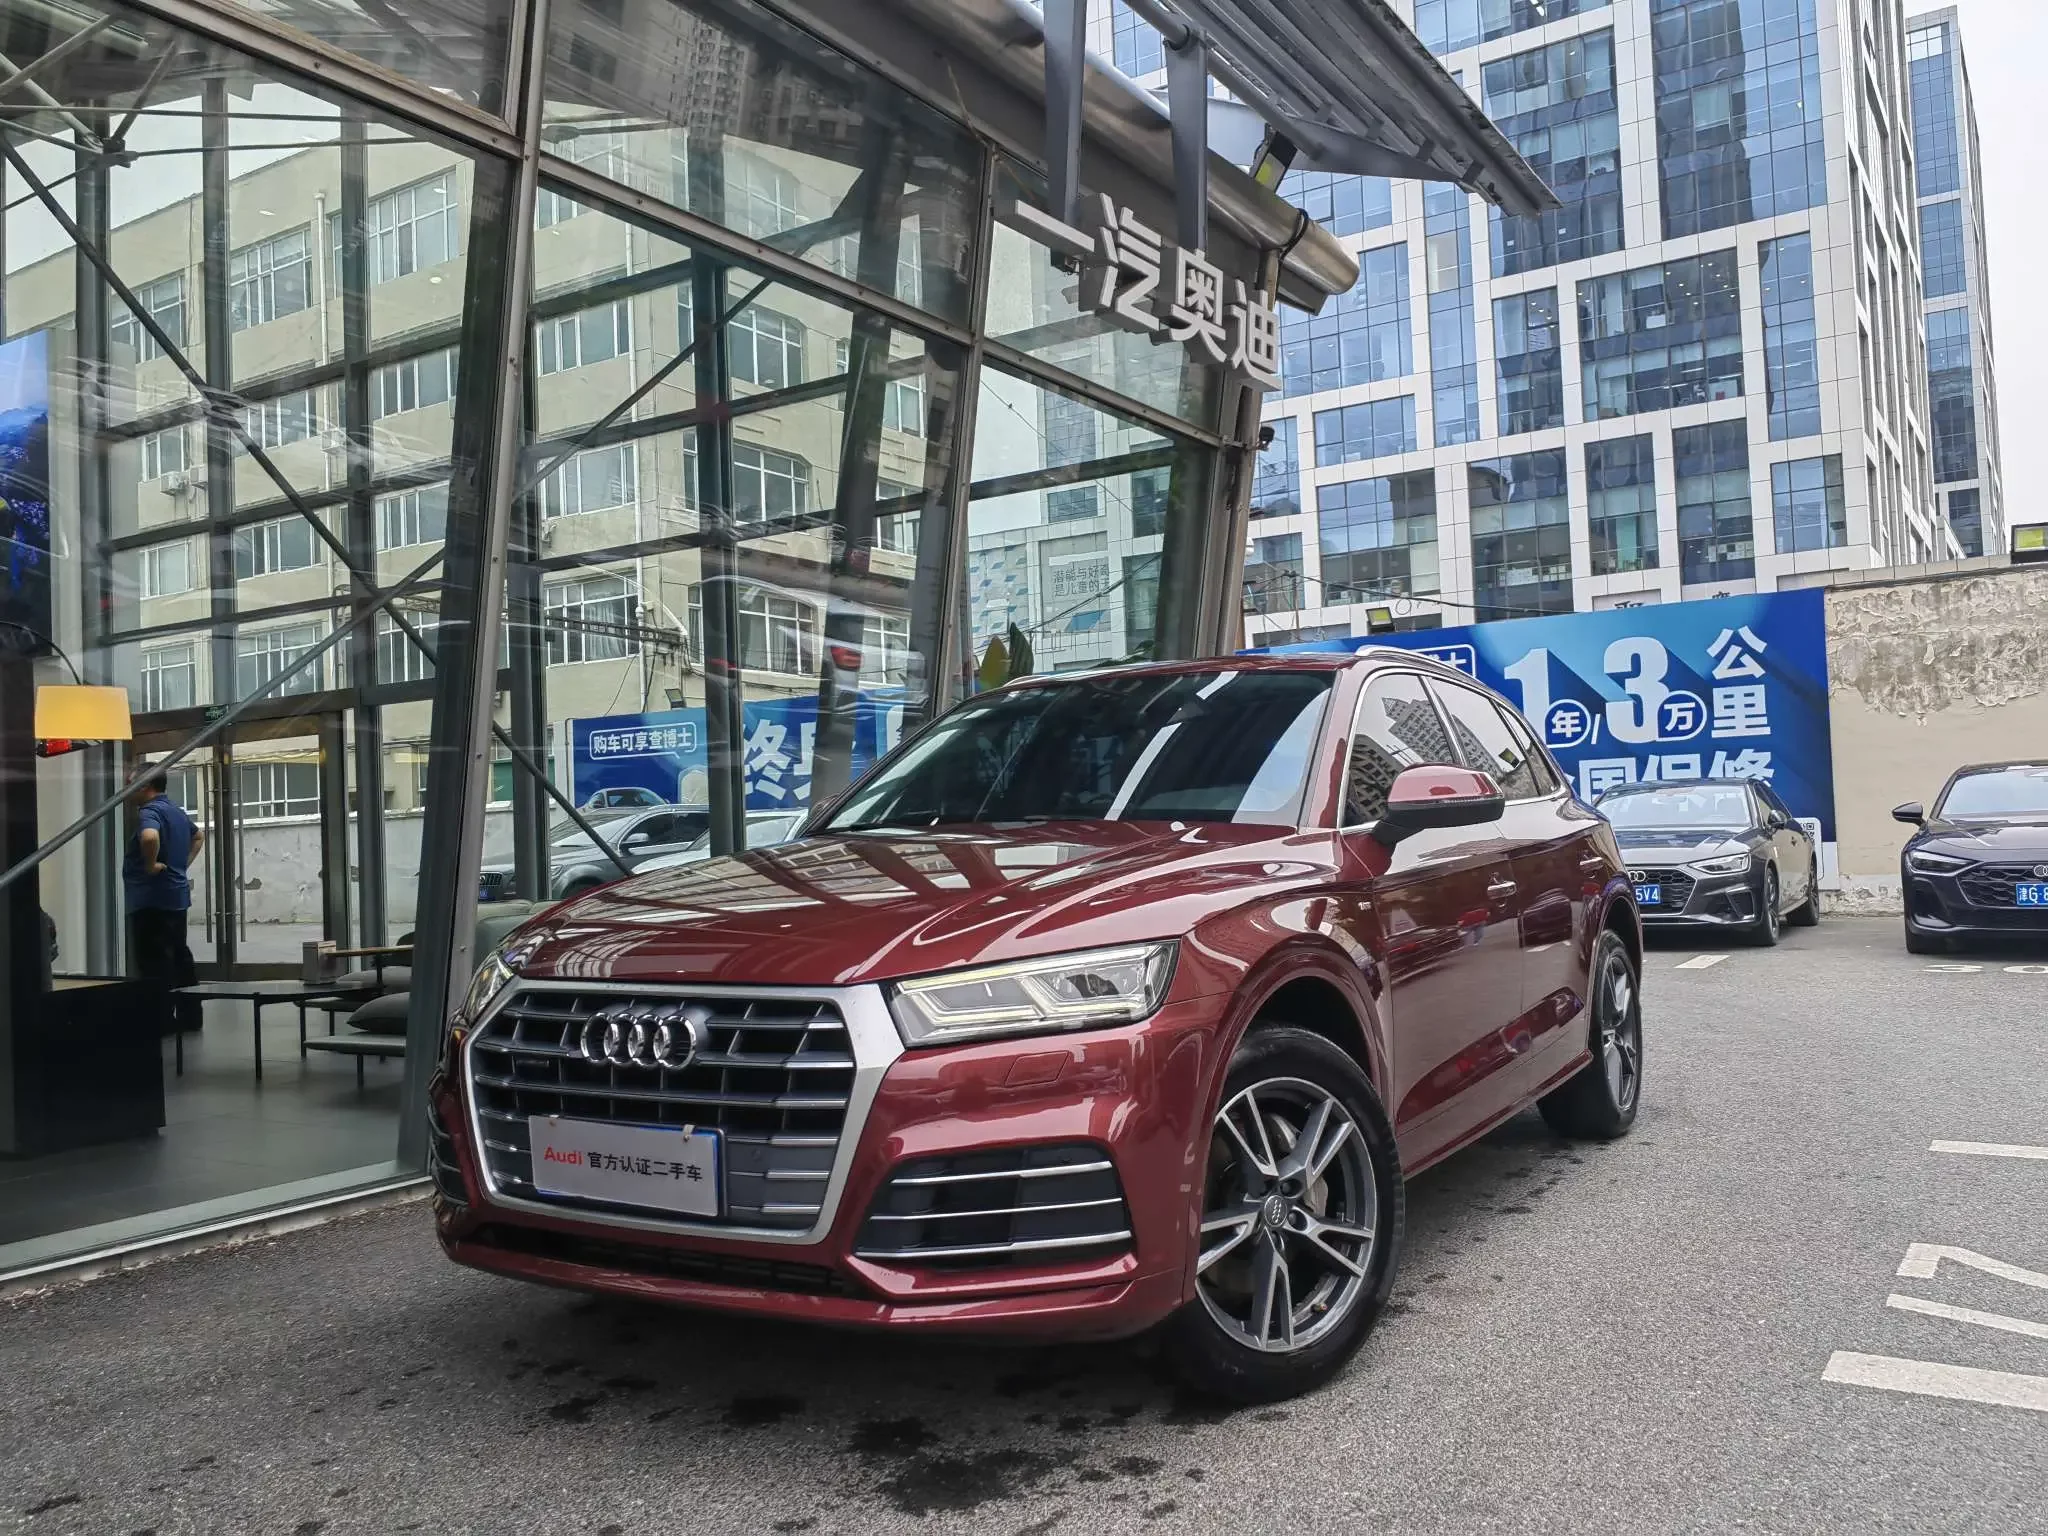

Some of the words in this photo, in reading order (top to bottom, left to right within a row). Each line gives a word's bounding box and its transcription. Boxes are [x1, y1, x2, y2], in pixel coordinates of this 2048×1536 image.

[1015, 193, 1282, 392] 一汽奥迪
[593, 728, 692, 753] 购车可享查博士
[544, 1146, 584, 1166] Audi
[587, 1151, 704, 1182] 官方认证二手车
